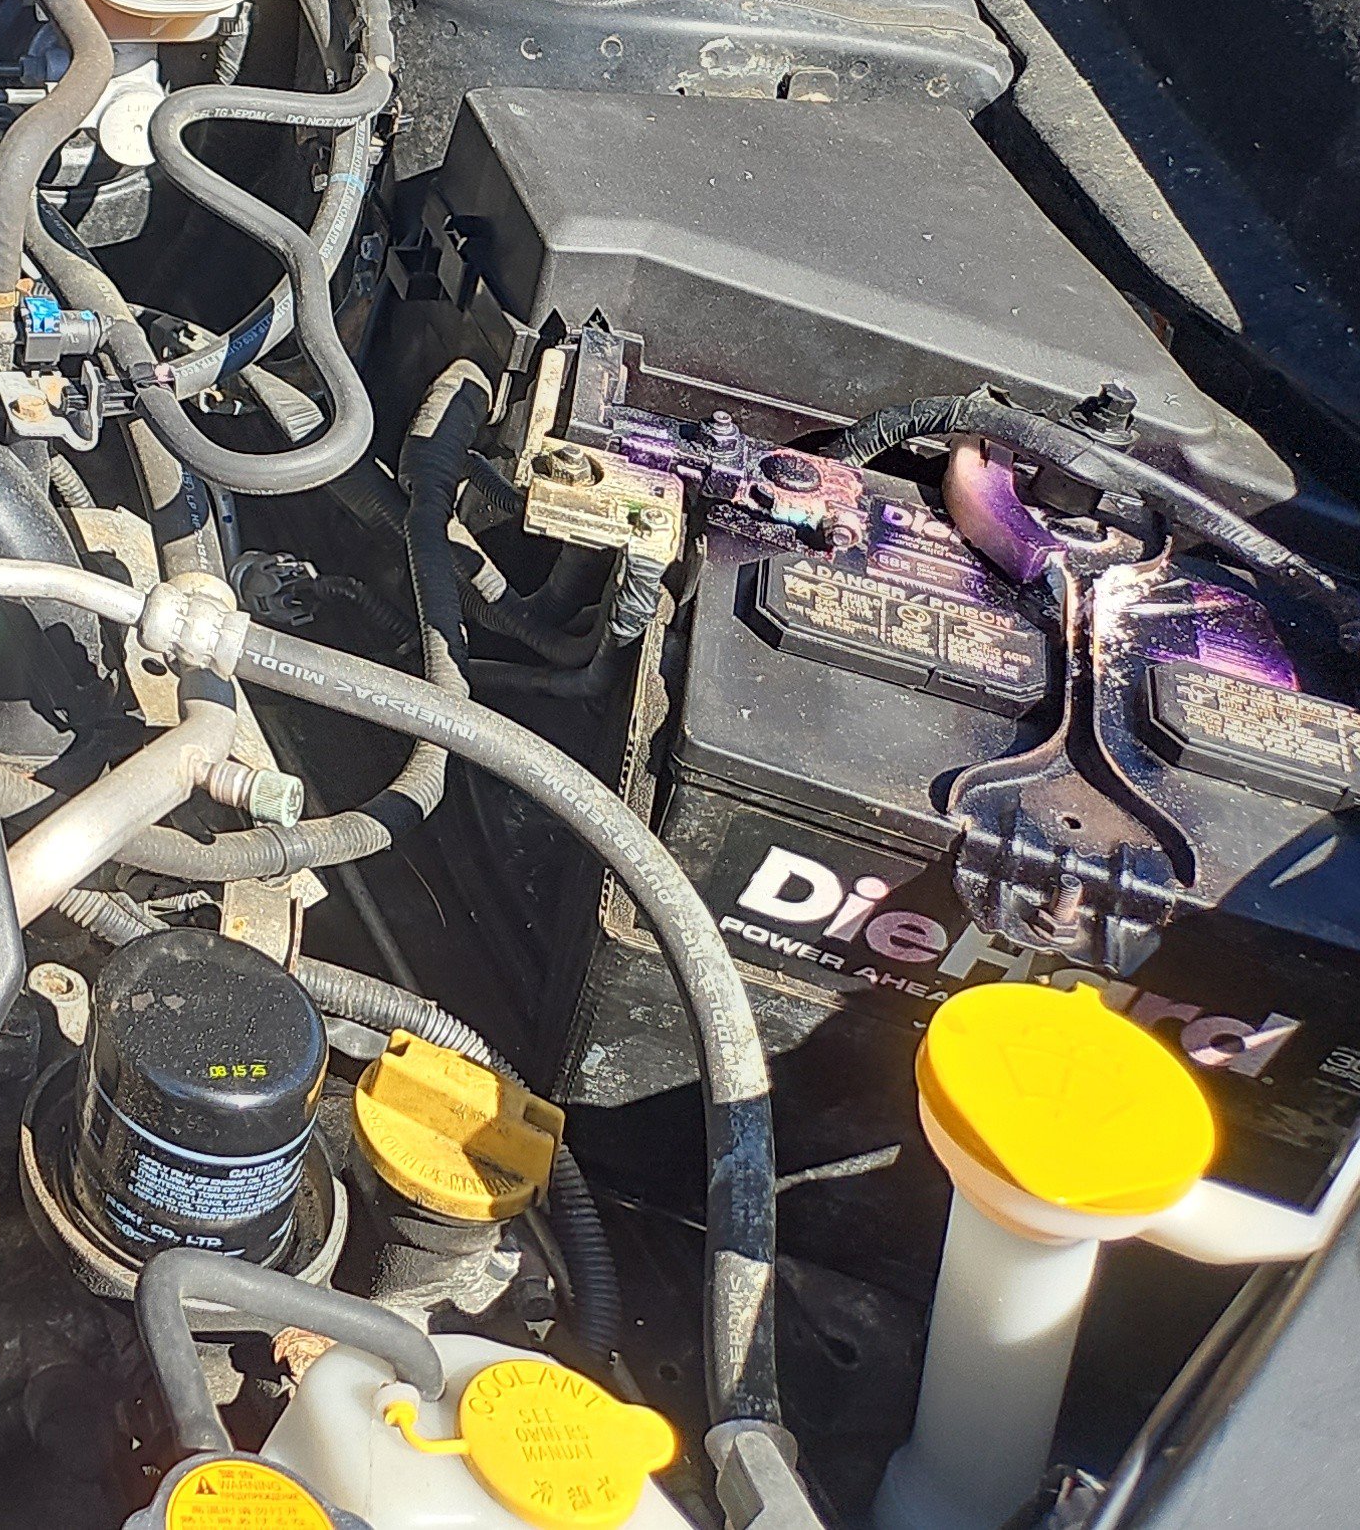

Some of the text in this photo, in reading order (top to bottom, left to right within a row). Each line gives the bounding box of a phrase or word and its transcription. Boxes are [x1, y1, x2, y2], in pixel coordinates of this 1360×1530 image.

[816, 565, 906, 601] DANGER
[930, 596, 1013, 629] POISON
[719, 915, 949, 1003] POWER AHEA
[233, 1064, 247, 1077] 15
[229, 1157, 286, 1179] CAUTION
[449, 1172, 517, 1197] MANUAL
[468, 1364, 610, 1417] COOLANT
[518, 1407, 557, 1424] SEE
[522, 1442, 594, 1463] MANUAL
[219, 1480, 282, 1491] WARNING
